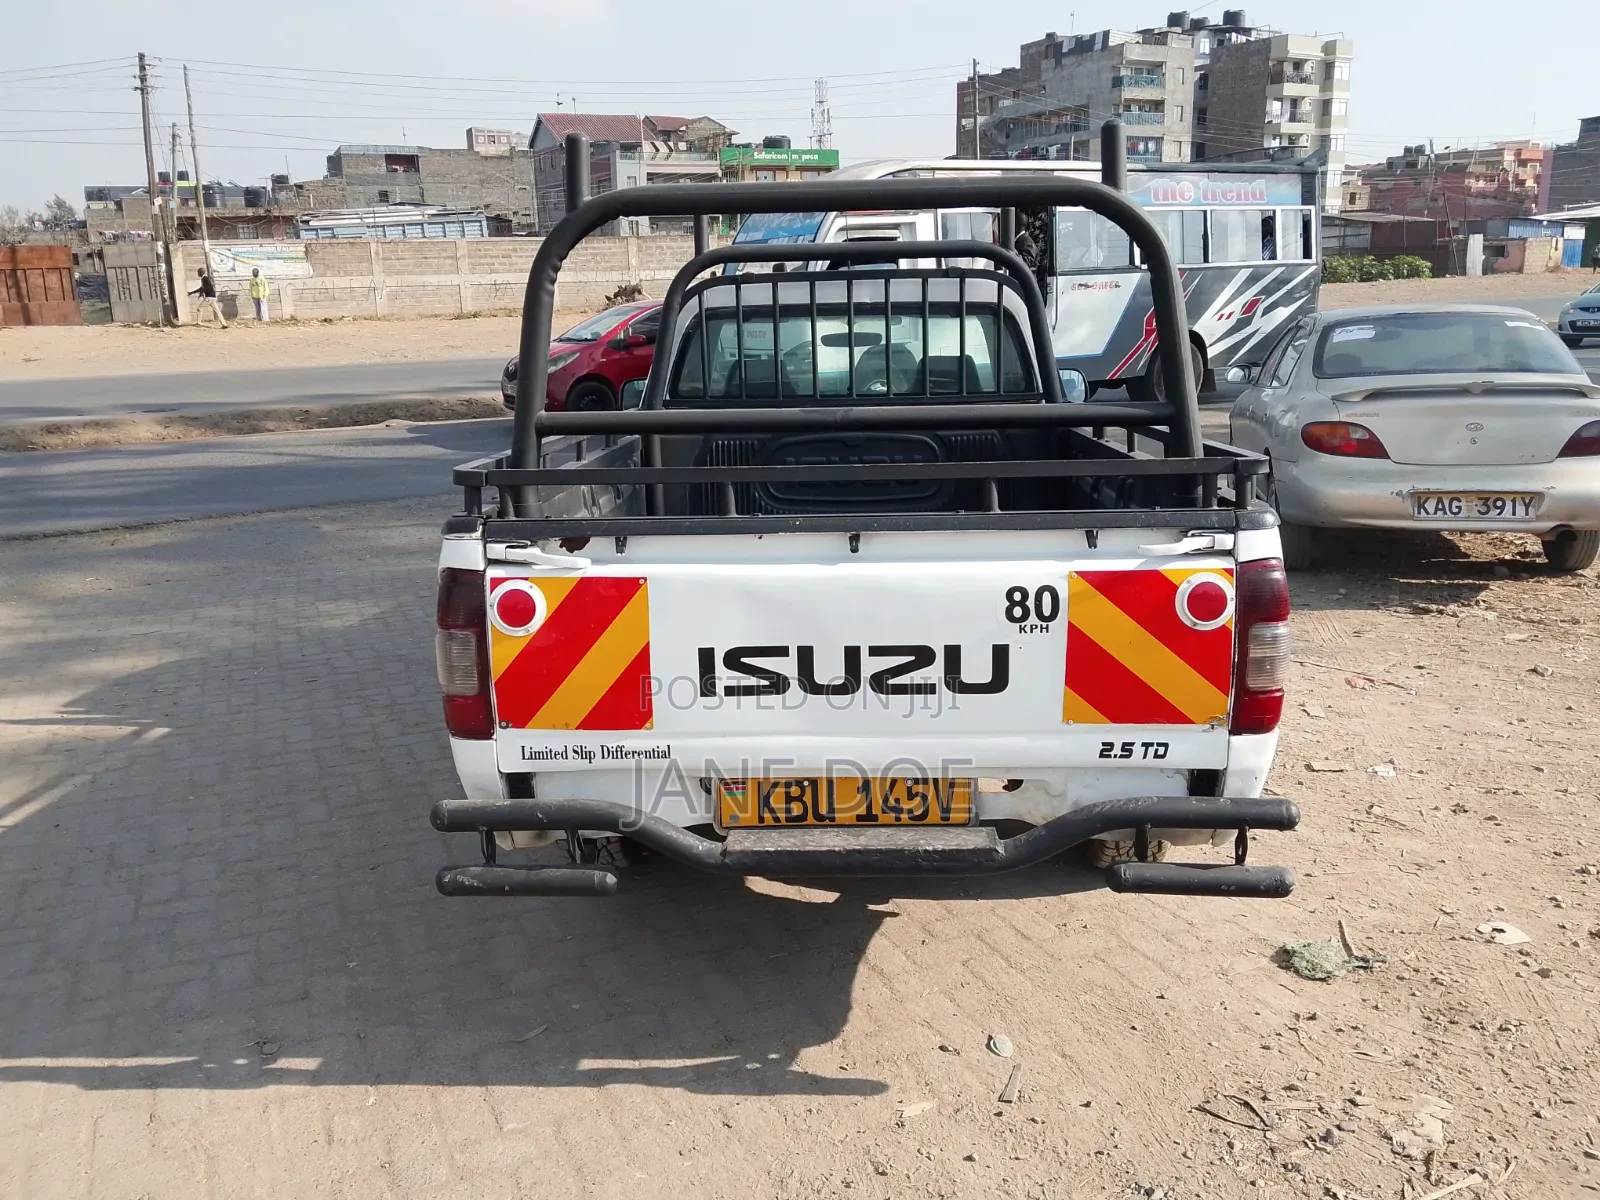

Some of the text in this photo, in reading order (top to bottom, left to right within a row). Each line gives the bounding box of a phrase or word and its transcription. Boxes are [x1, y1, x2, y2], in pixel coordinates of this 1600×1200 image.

[753, 151, 788, 160] Safaricom
[1150, 178, 1268, 204] the trend
[1415, 495, 1535, 517] KAG 391Y
[1005, 584, 1060, 624] 80
[1018, 623, 1050, 634] KPH
[697, 643, 1010, 698] ISUZU
[520, 744, 672, 765] Limited Slip Differential
[1098, 741, 1170, 760] 2.5 TD
[757, 777, 957, 825] KBU 145V
